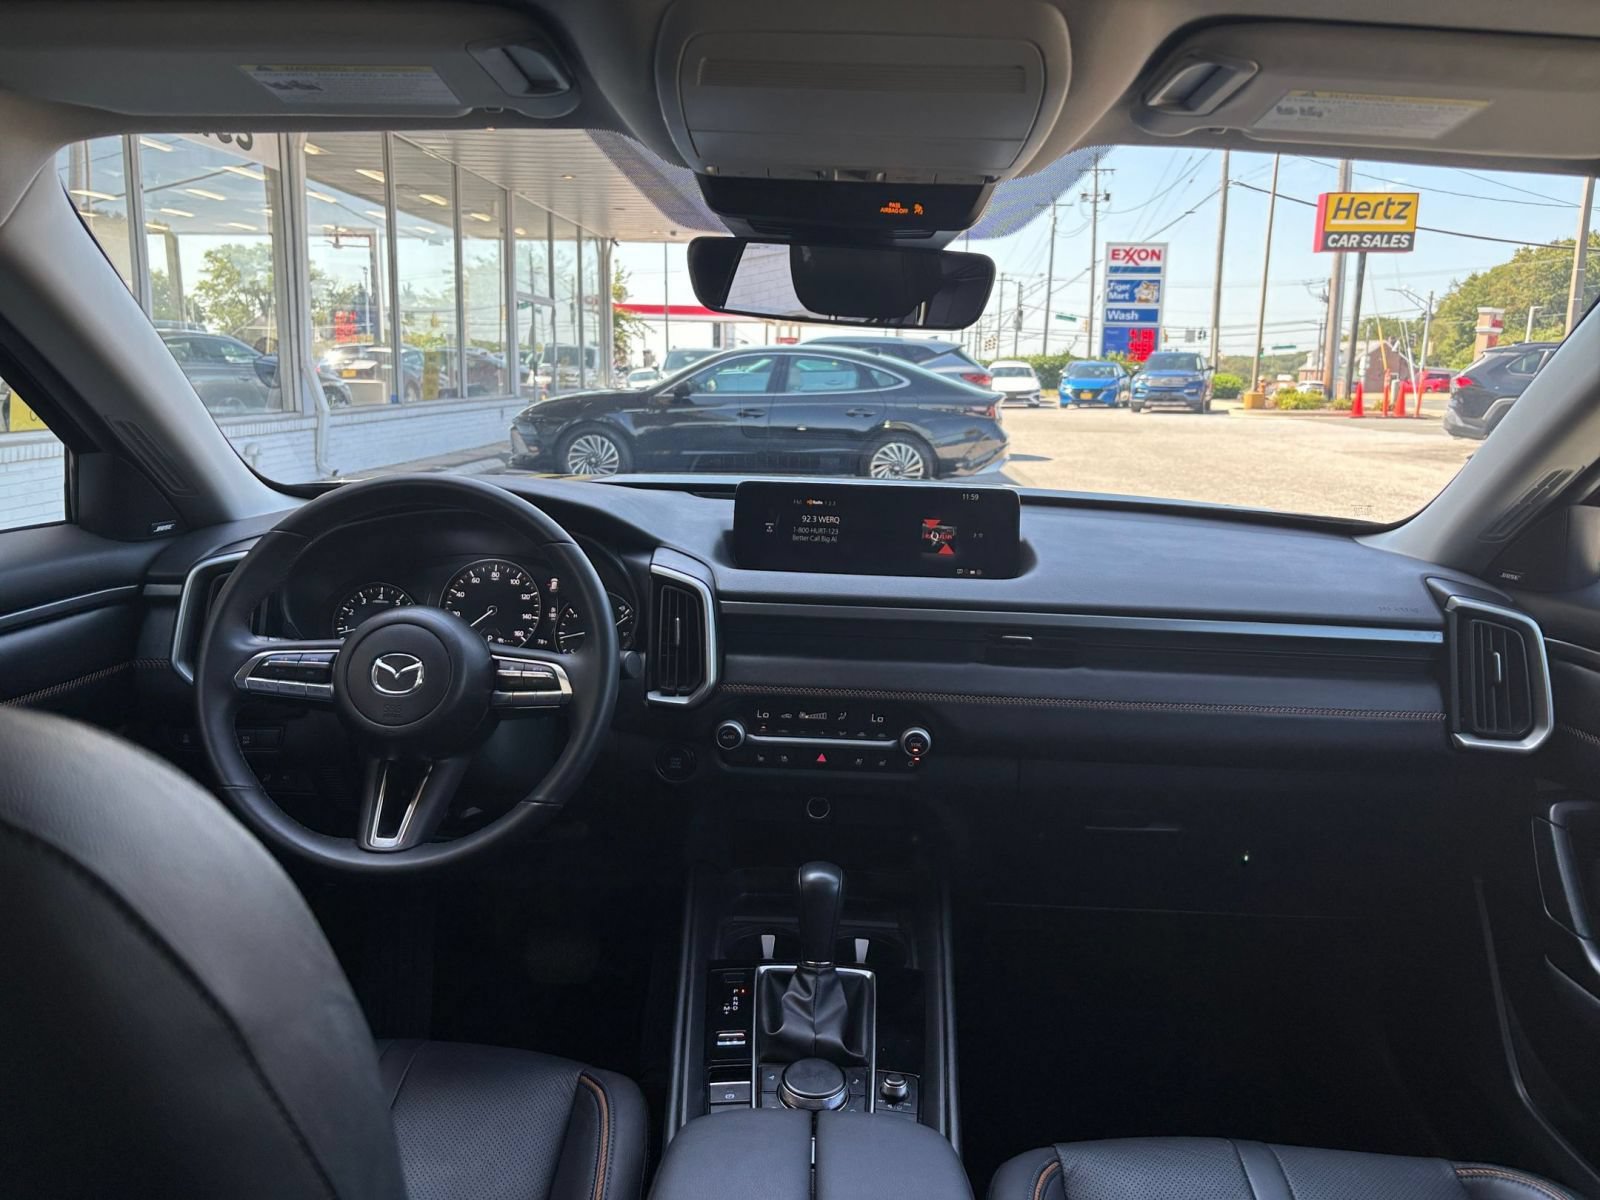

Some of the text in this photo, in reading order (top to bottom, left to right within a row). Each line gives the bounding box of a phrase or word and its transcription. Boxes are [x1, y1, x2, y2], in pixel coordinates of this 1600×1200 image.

[1331, 197, 1412, 220] Hertz
[1327, 234, 1411, 248] CAR SALES
[1111, 247, 1162, 266] EXXON
[1109, 282, 1130, 291] Tiger
[1108, 292, 1130, 300] Mart
[1107, 310, 1138, 320] Wash
[802, 515, 840, 524] 92.3 WERQ
[757, 709, 769, 718] Lo
[871, 714, 884, 722] Lo
